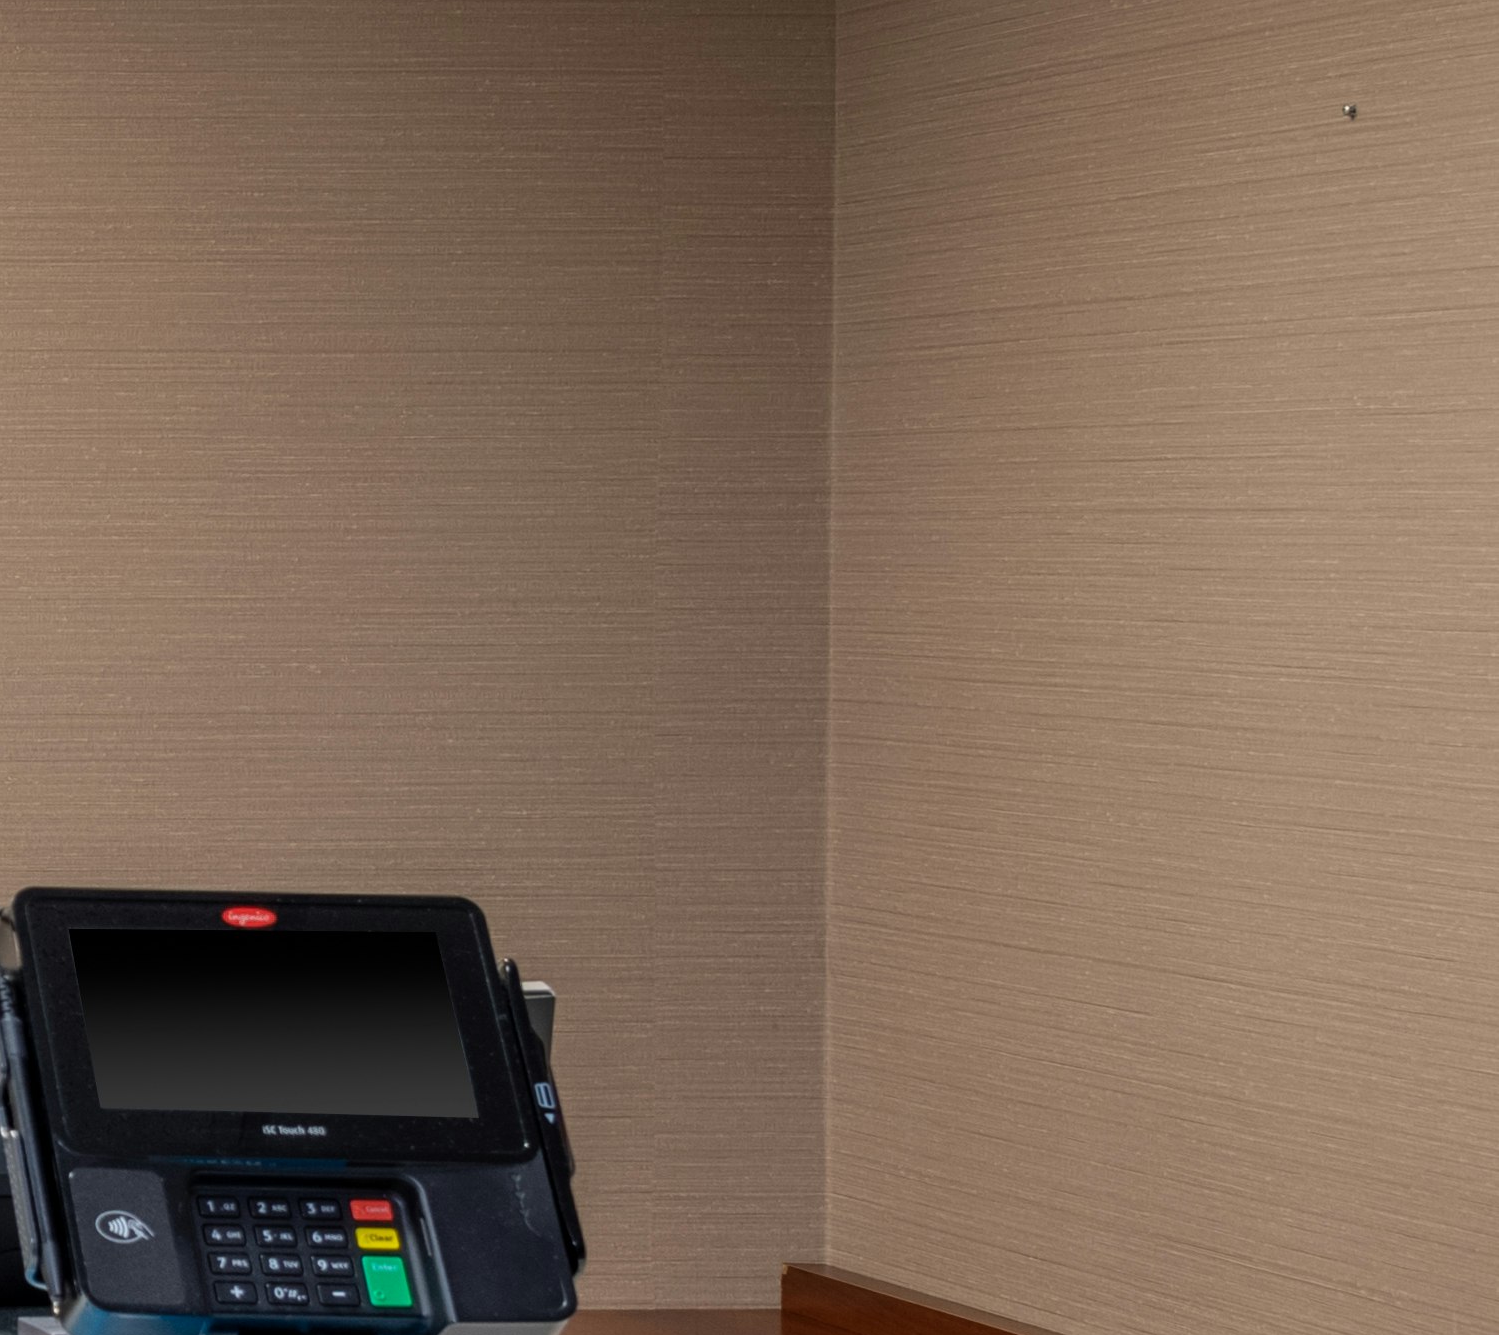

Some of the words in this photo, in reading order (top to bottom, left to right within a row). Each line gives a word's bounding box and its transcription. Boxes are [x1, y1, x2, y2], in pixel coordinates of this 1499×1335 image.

[278, 1125, 306, 1136] Touch
[207, 1200, 216, 1212] 1
[256, 1202, 266, 1214] 2
[306, 1203, 316, 1214] 3
[211, 1229, 222, 1241] 4
[262, 1230, 272, 1242] 5
[312, 1231, 323, 1243] 6
[370, 1234, 393, 1242] Clear
[216, 1257, 227, 1269] 7
[268, 1258, 279, 1270] 8
[317, 1259, 328, 1271] 9
